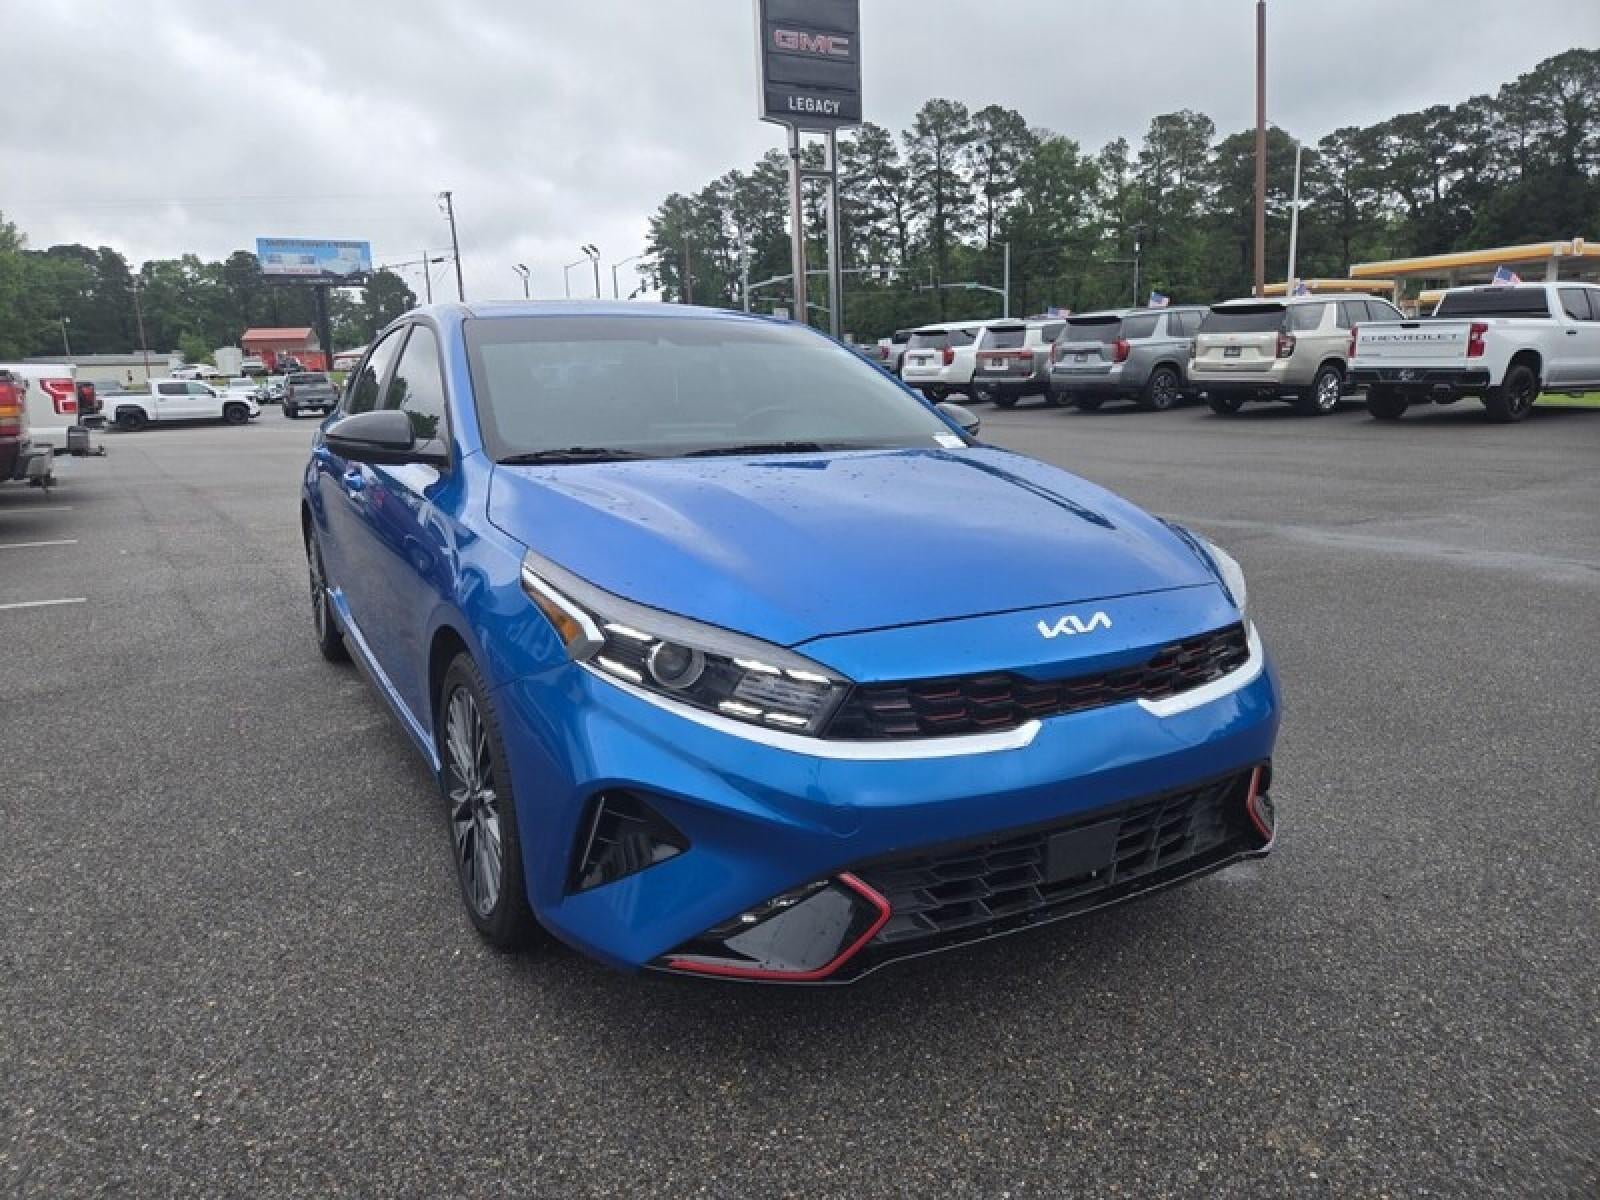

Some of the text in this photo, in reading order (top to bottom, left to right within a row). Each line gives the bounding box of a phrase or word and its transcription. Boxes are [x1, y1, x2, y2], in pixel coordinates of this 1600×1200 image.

[774, 29, 849, 55] GMC
[788, 96, 840, 115] LEGACY
[1360, 332, 1458, 341] CHEVROLET
